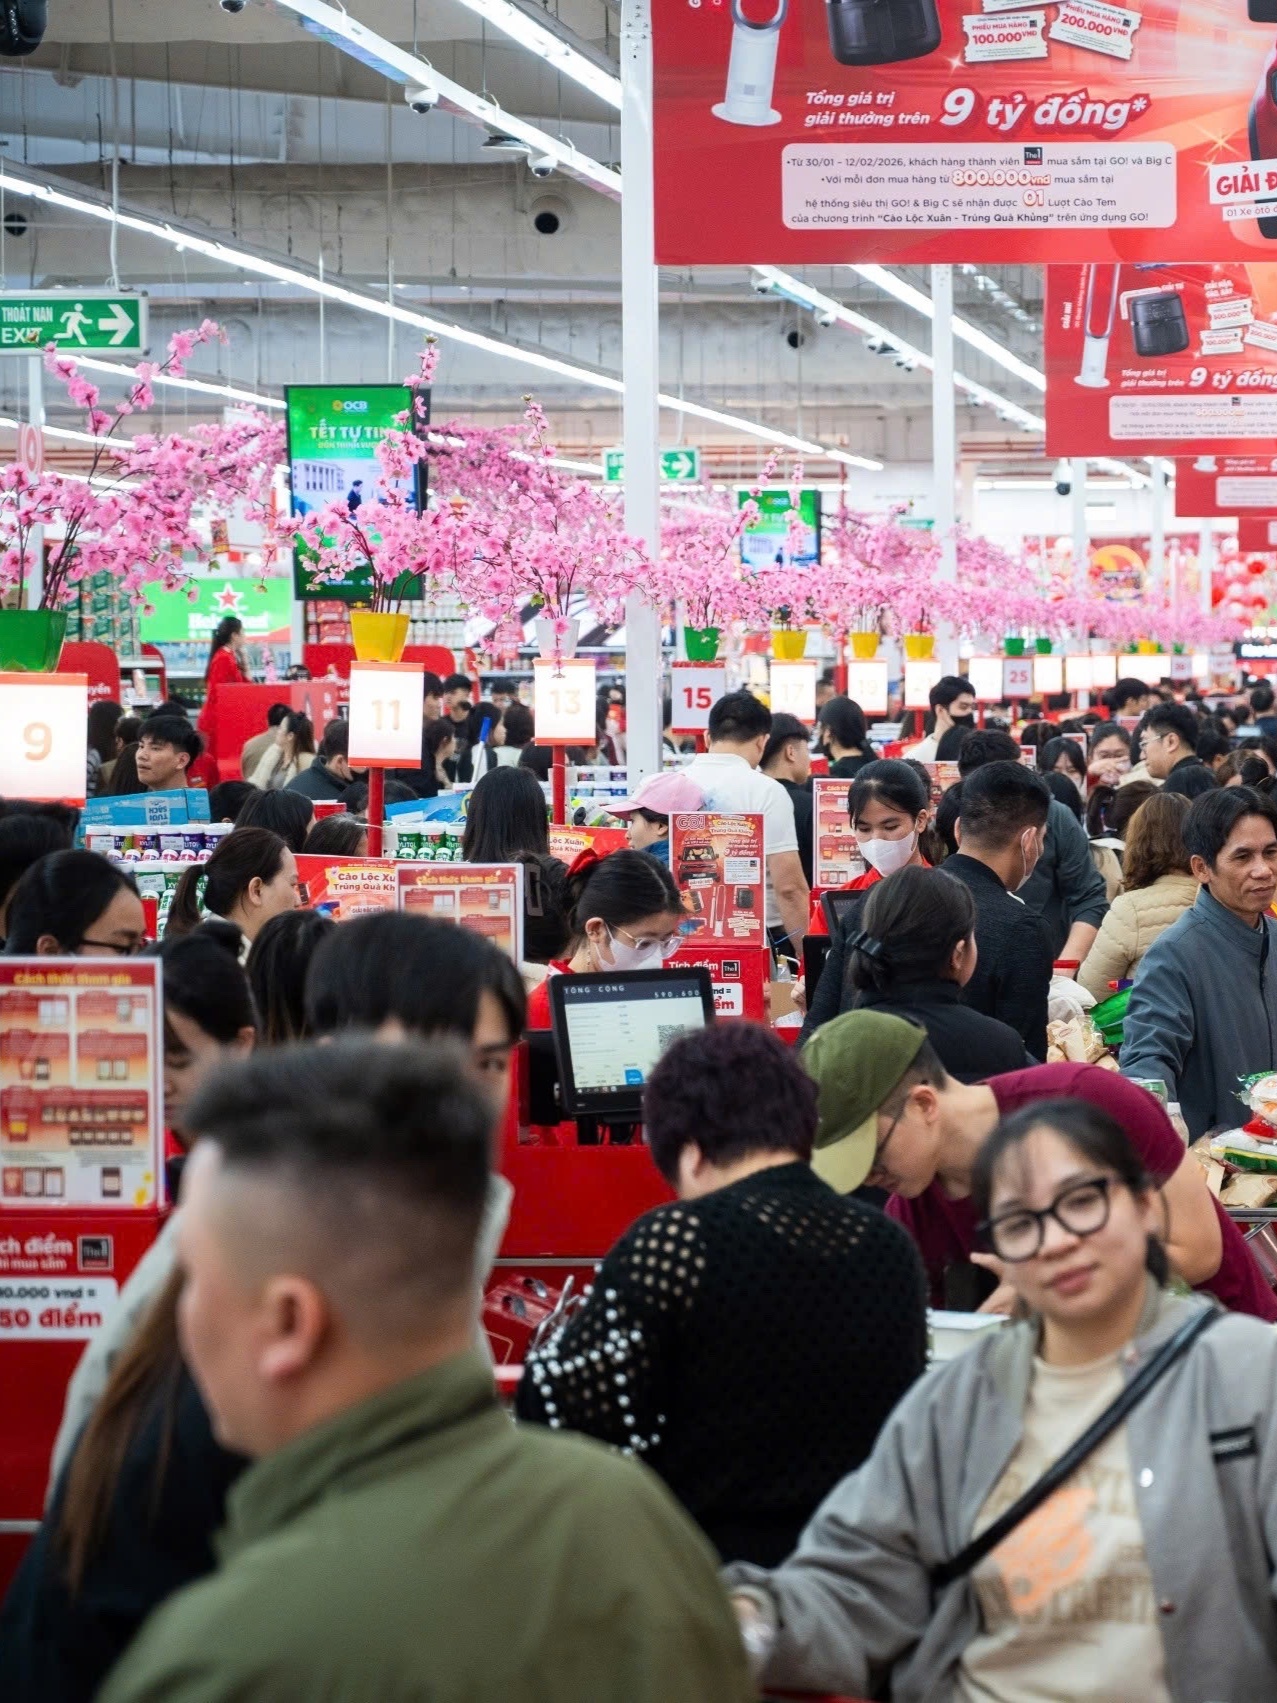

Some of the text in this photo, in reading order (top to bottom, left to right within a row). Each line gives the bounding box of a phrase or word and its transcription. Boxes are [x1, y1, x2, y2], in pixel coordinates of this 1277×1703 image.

[806, 89, 896, 107] Tổng giá trị
[804, 110, 930, 127] giải thưởng trên
[939, 87, 976, 126] 9
[987, 93, 1027, 131] tỷ
[805, 158, 834, 167] 30/01
[909, 158, 938, 166] khách
[941, 158, 966, 168] hàng
[968, 157, 996, 166] thành
[1000, 157, 1020, 165] viên
[1109, 157, 1128, 165] GO!
[1131, 156, 1143, 165] và
[1146, 156, 1162, 167] Big
[1165, 156, 1172, 165] C
[912, 175, 937, 186] hàng
[1054, 176, 1076, 184] mua
[1216, 166, 1261, 196] GIẢI
[852, 198, 872, 208] siêu
[891, 198, 910, 208] GO!
[923, 198, 939, 209] Big
[942, 198, 949, 207] C
[1022, 189, 1045, 207] 01
[1096, 198, 1117, 207] Tem
[927, 213, 952, 222] Xuân
[1057, 213, 1076, 222] trên
[1129, 213, 1149, 221] GO!
[1239, 207, 1251, 216] Xe
[2, 302, 31, 322] THOÁT
[1188, 367, 1208, 388] 9
[1212, 369, 1232, 389] tỷ
[343, 400, 368, 410] OCB
[309, 417, 337, 439] TẾT
[340, 425, 362, 443] TỰ
[549, 687, 581, 715] 13
[682, 687, 712, 709] 15
[372, 699, 400, 731] 11
[22, 721, 53, 761] 9
[338, 871, 396, 884] Cào Lộc Xu
[38, 1304, 102, 1328] điểm
